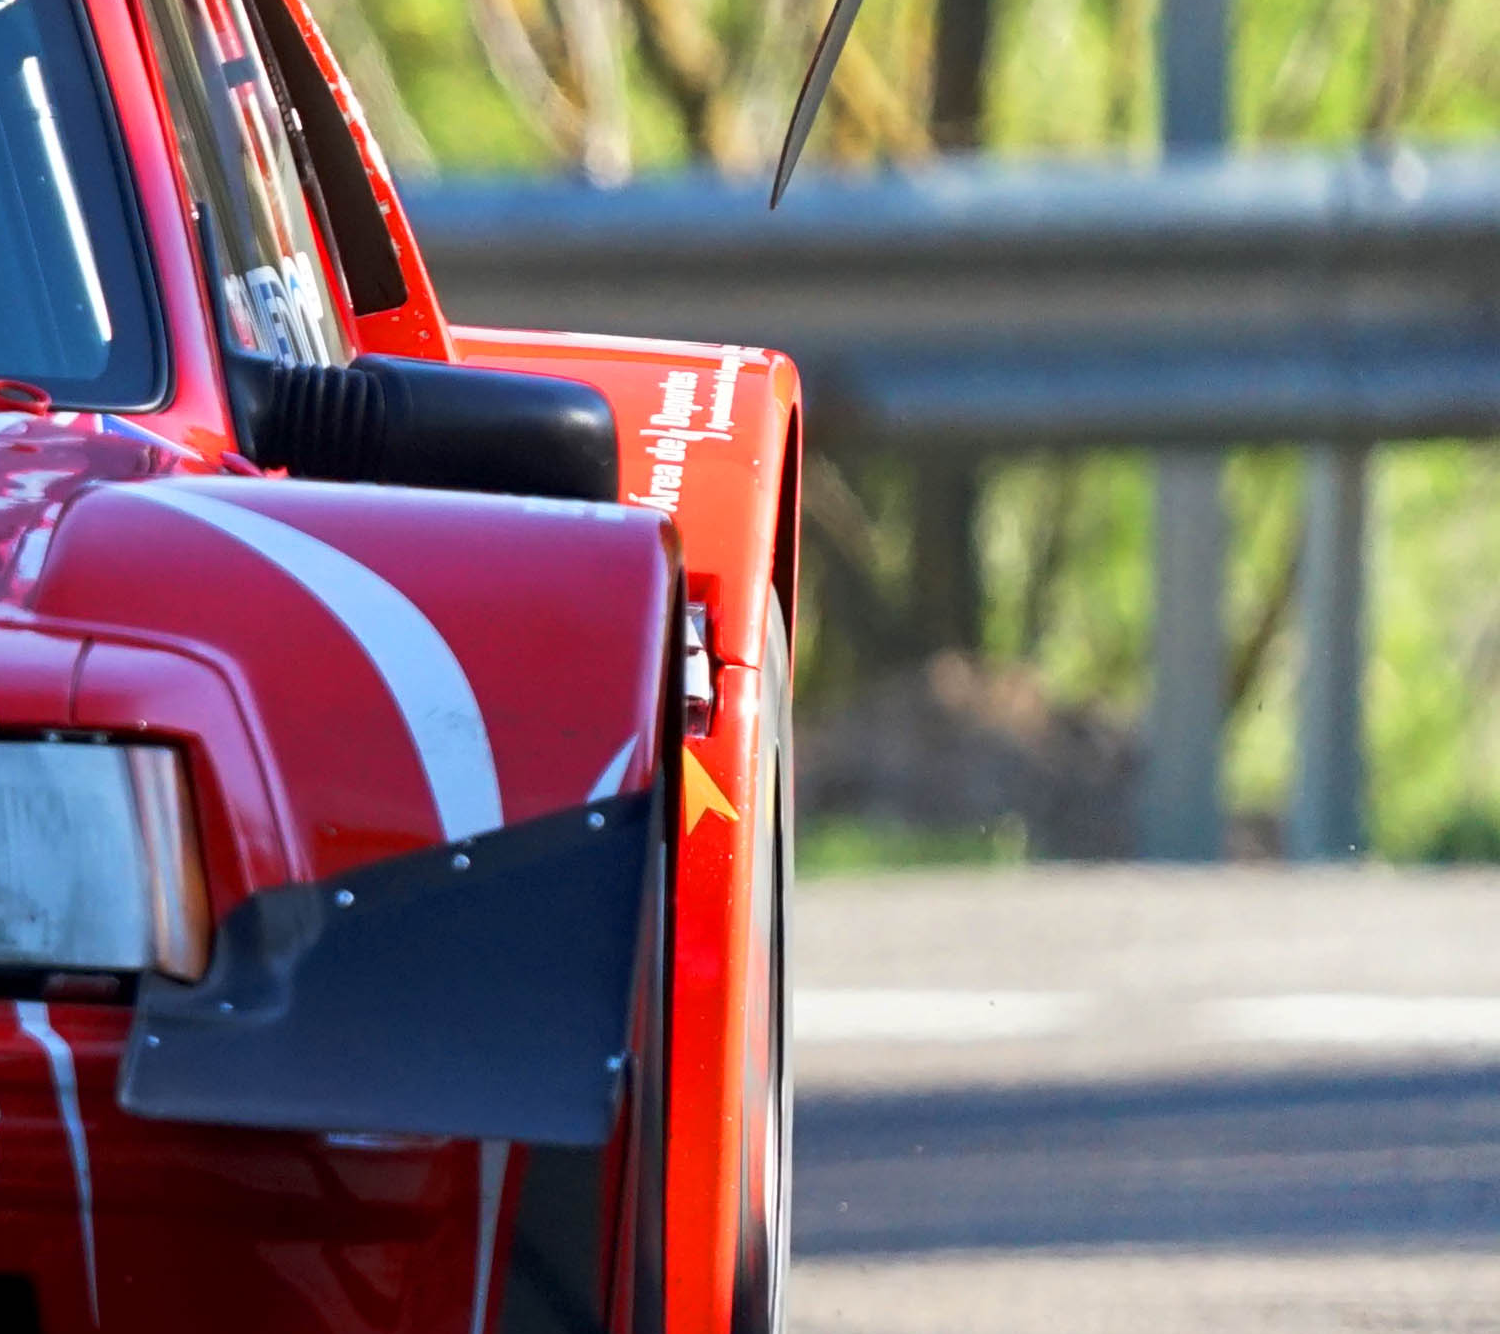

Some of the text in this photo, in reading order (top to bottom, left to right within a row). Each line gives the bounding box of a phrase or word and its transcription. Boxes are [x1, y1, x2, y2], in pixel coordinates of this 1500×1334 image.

[627, 370, 704, 513] Área de Deportes
